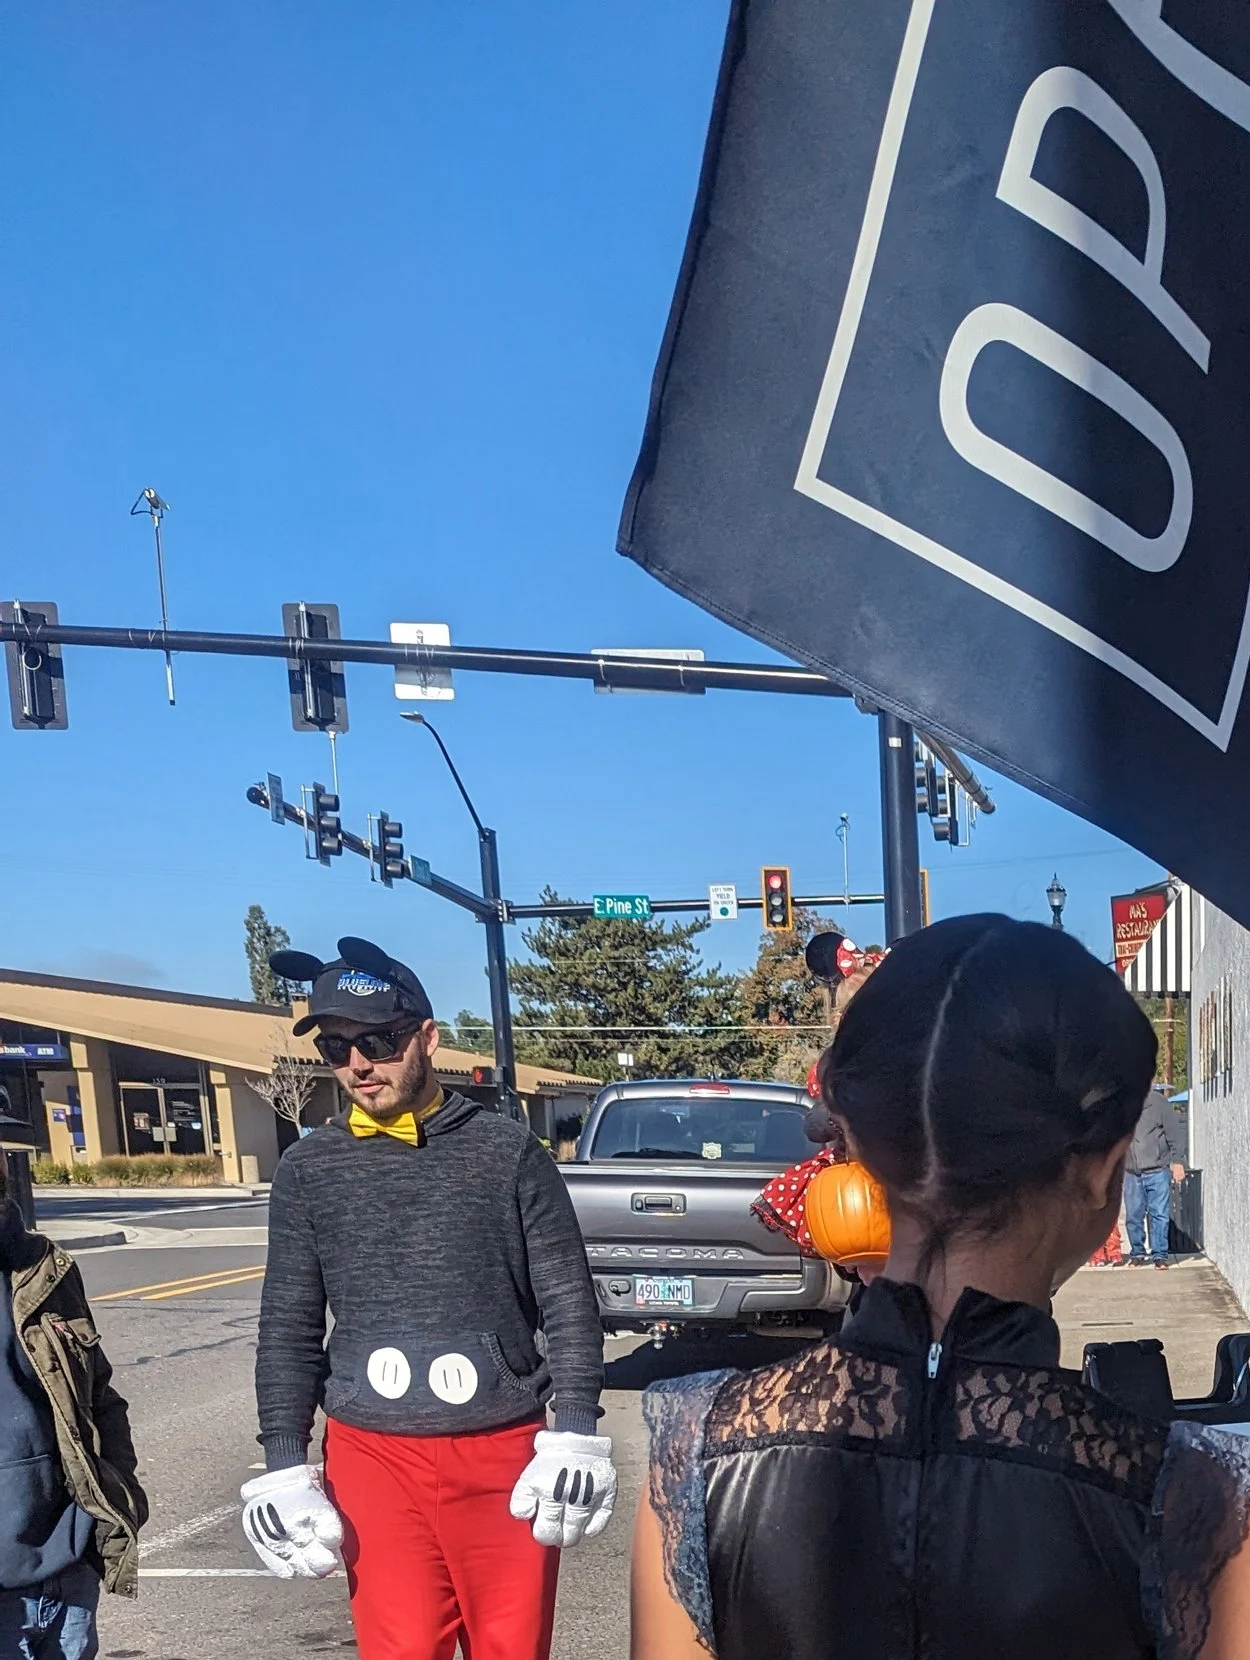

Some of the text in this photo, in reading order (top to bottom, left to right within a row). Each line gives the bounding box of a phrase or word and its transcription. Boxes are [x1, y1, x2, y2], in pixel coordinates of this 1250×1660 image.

[606, 897, 632, 914] Pine
[634, 897, 649, 914] St
[37, 1047, 54, 1056] ATM
[585, 1247, 744, 1259] TACOMA
[638, 1284, 690, 1300] 490 NMD
